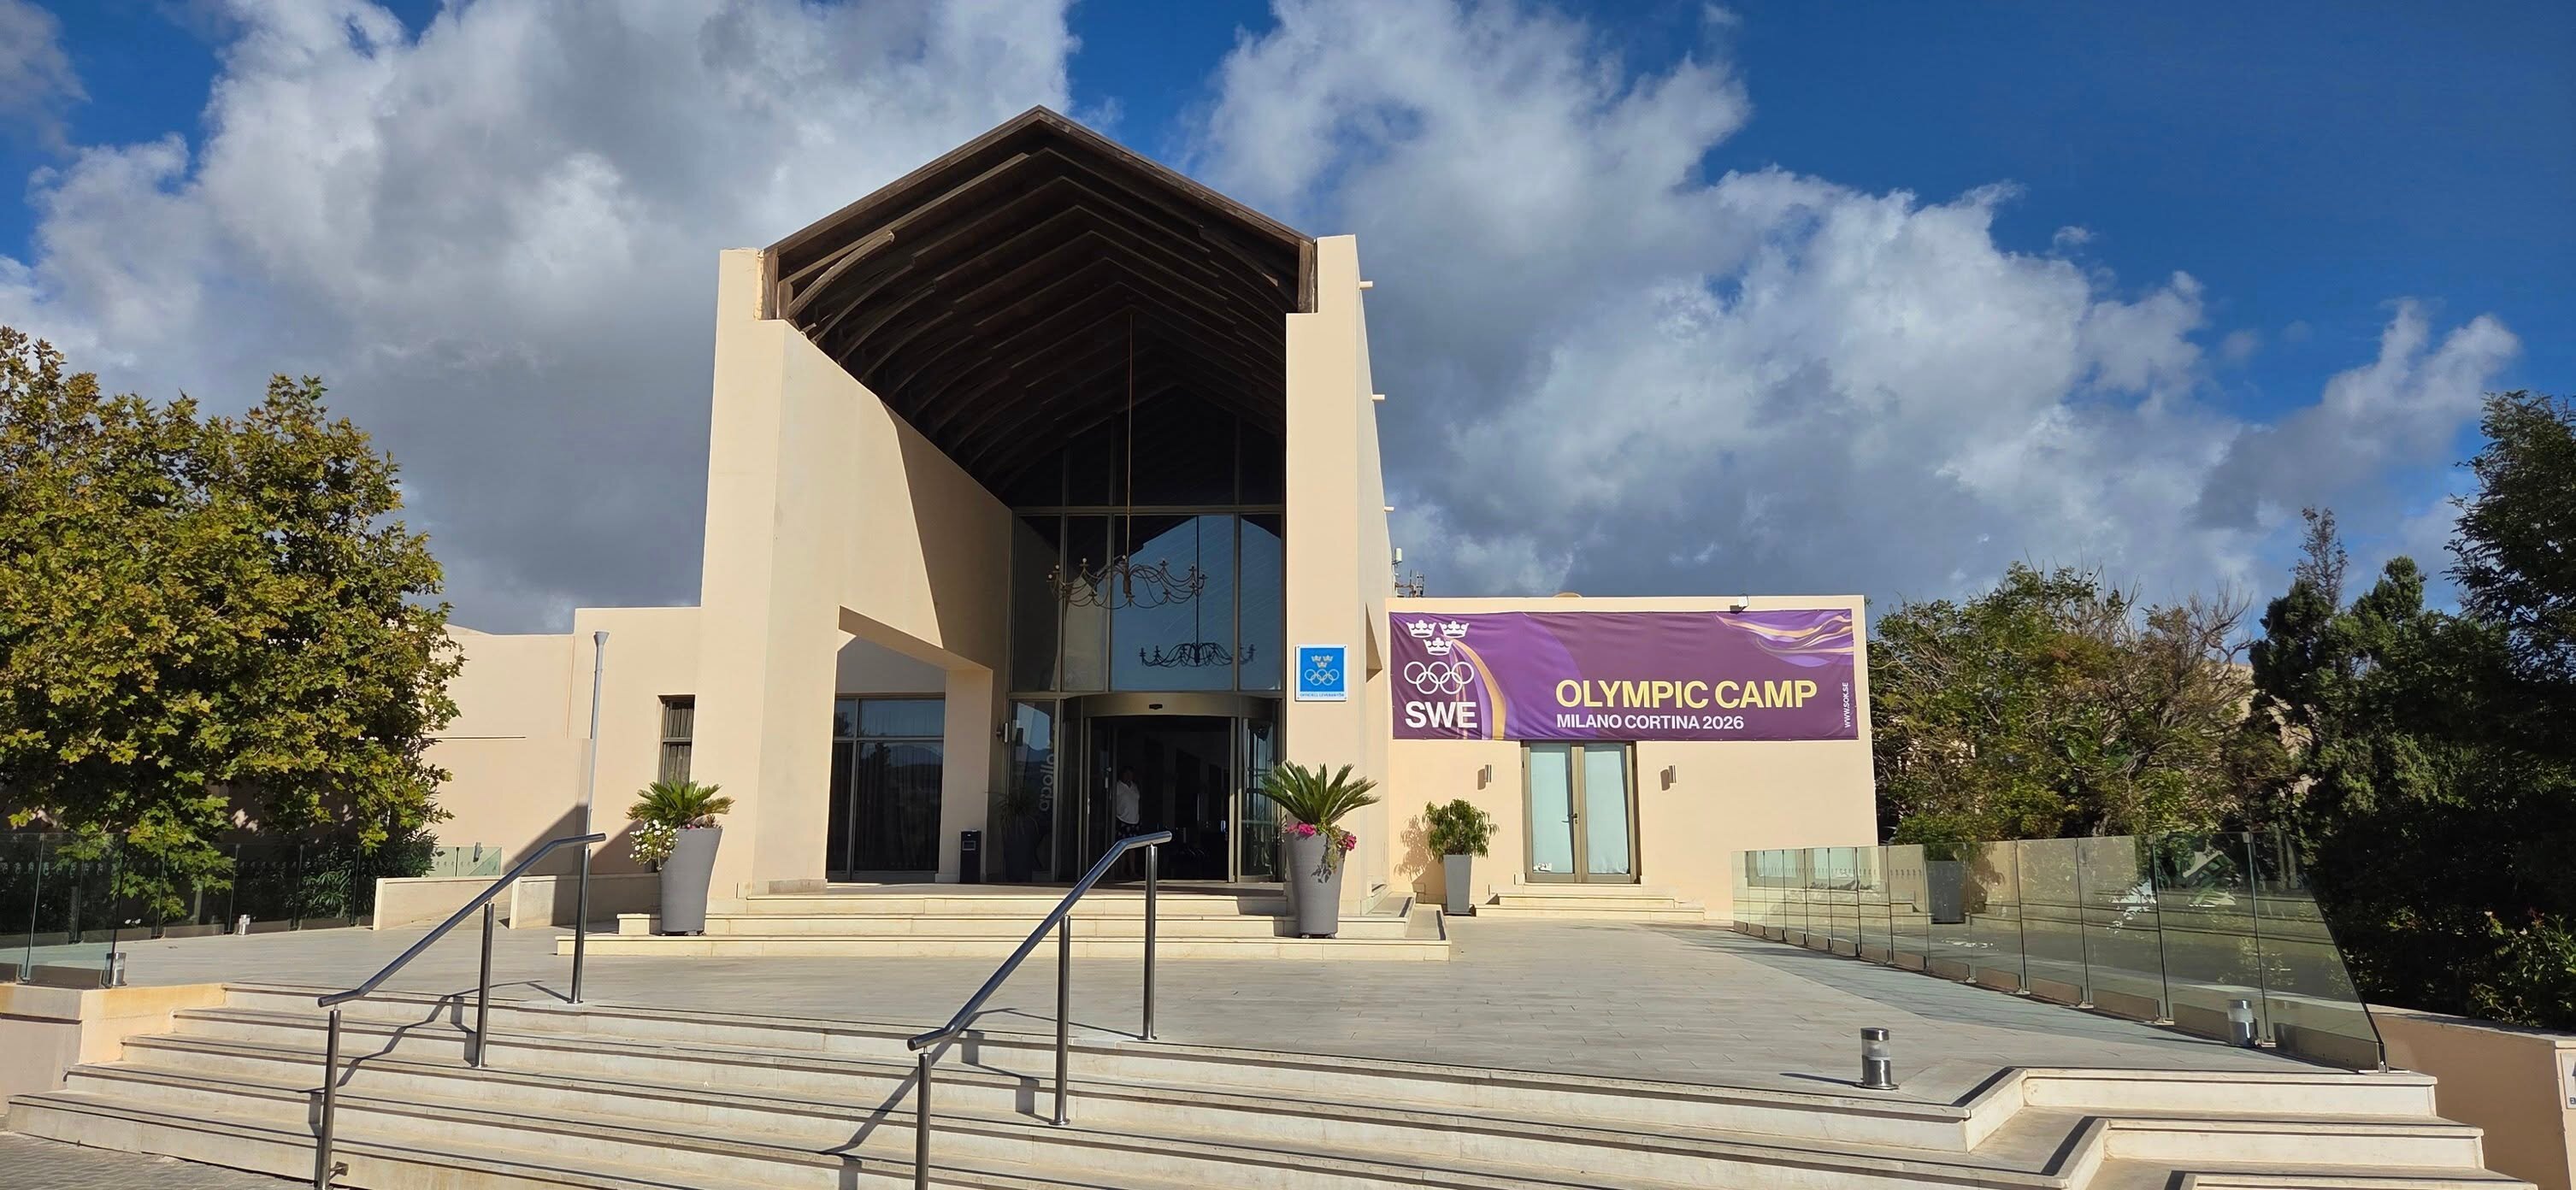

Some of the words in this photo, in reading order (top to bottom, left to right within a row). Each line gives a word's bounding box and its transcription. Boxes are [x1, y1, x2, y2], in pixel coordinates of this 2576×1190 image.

[1556, 680, 1709, 709] OLYMPIC
[1715, 680, 1818, 709] CAMP
[1842, 682, 1852, 728] WWW.SOK.SE
[1405, 701, 1477, 728] SWE
[1557, 714, 1622, 729] MILANO
[1624, 715, 1700, 729] CORTINA
[1702, 716, 1744, 729] 2026
